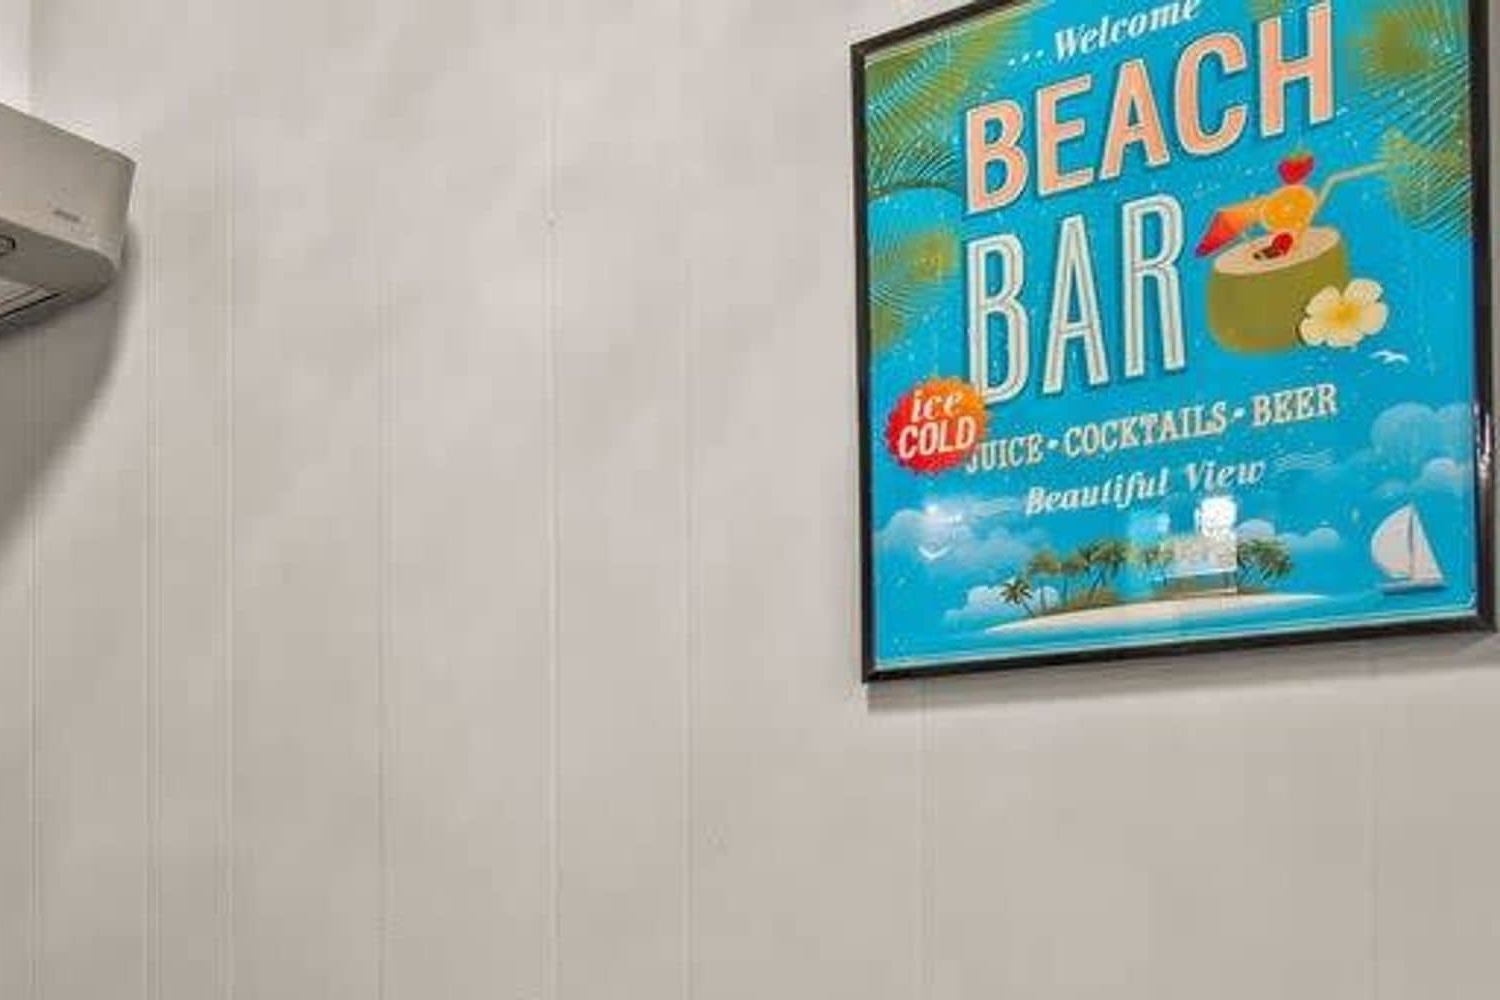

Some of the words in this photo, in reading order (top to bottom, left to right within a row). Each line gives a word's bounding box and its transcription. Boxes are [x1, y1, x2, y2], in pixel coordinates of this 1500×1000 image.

[1055, 0, 1198, 61] Welcome
[964, 4, 1336, 215] BEACH
[967, 193, 1185, 404] BAR
[911, 389, 962, 422] ice
[965, 432, 1044, 473] JUICE
[1064, 401, 1227, 457] COCKTAILS
[1251, 383, 1338, 427] BEER
[899, 416, 976, 459] COLD
[1026, 467, 1170, 516] Beautiful
[1187, 459, 1265, 492] View
